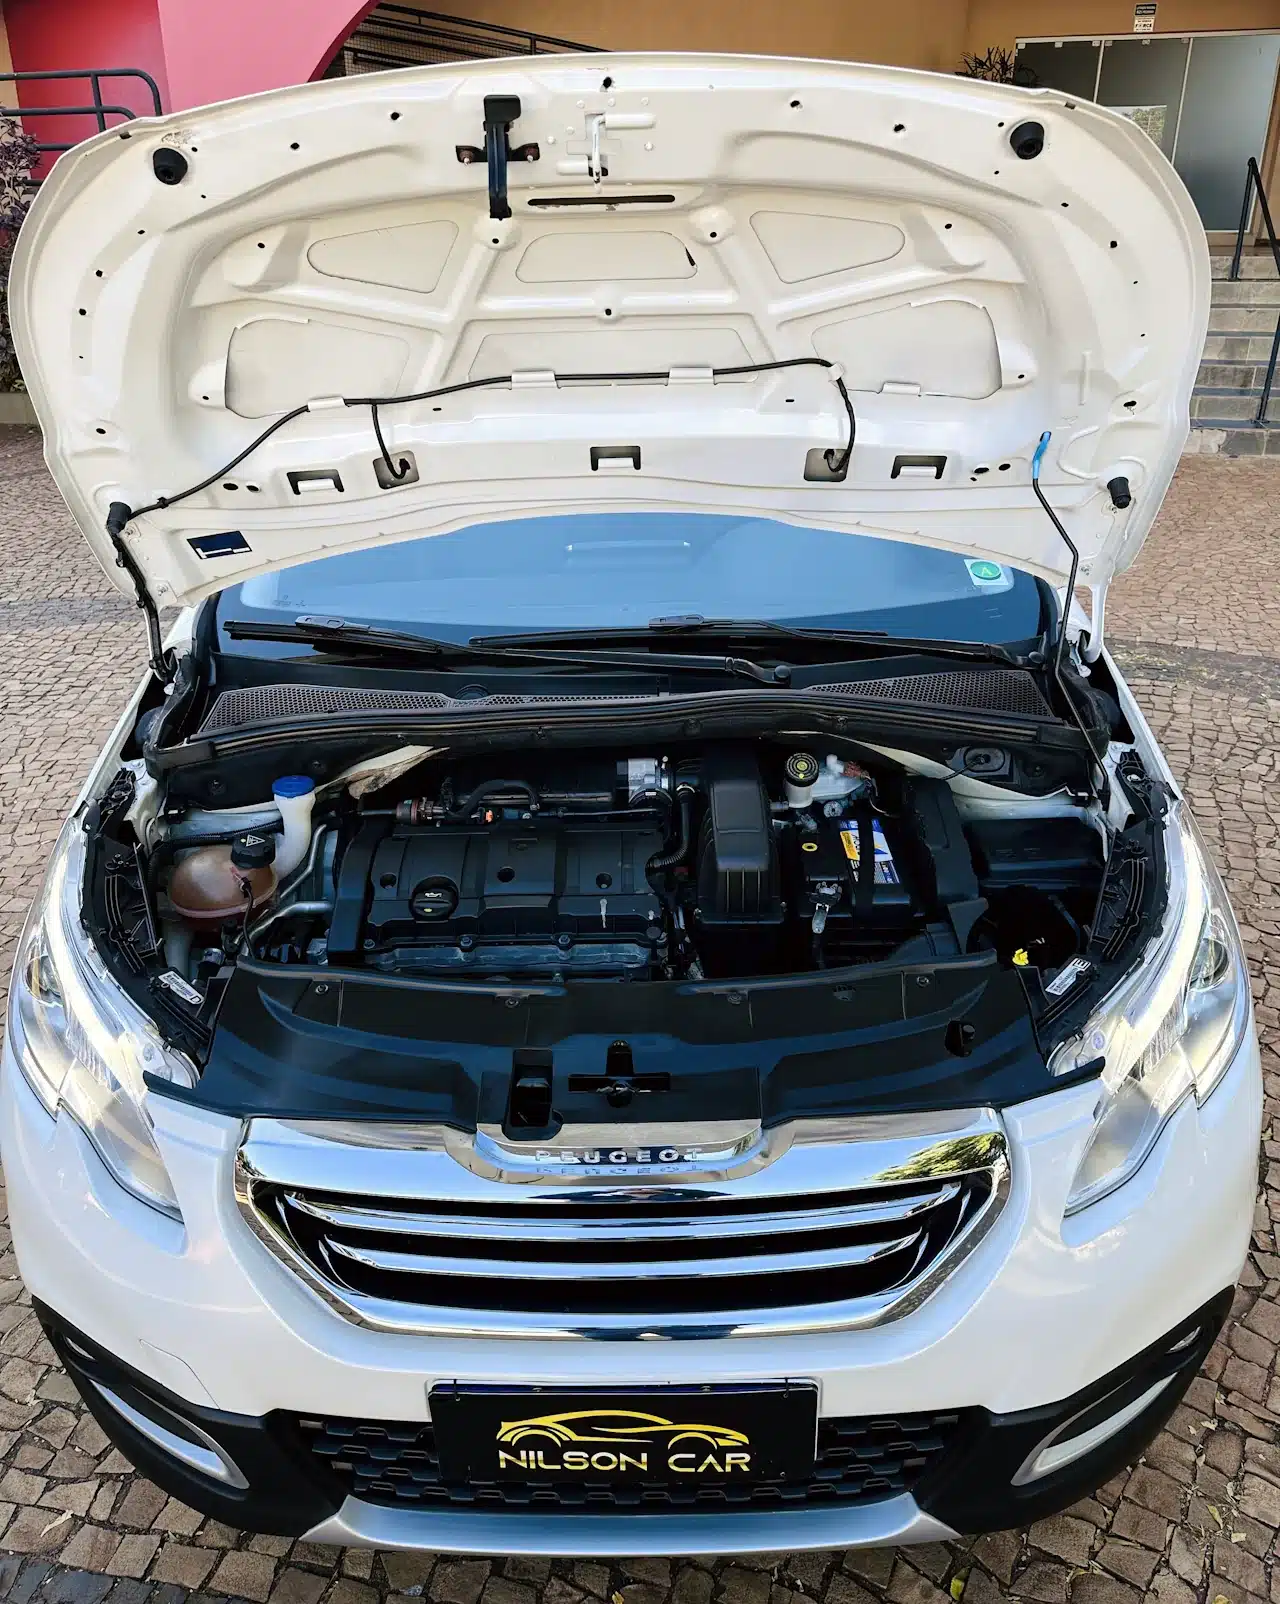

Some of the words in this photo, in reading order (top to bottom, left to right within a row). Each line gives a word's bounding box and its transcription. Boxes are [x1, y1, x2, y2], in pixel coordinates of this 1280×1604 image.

[535, 1148, 702, 1164] PEUGEOT
[498, 1449, 648, 1472] NILSON
[668, 1452, 750, 1473] CAR
